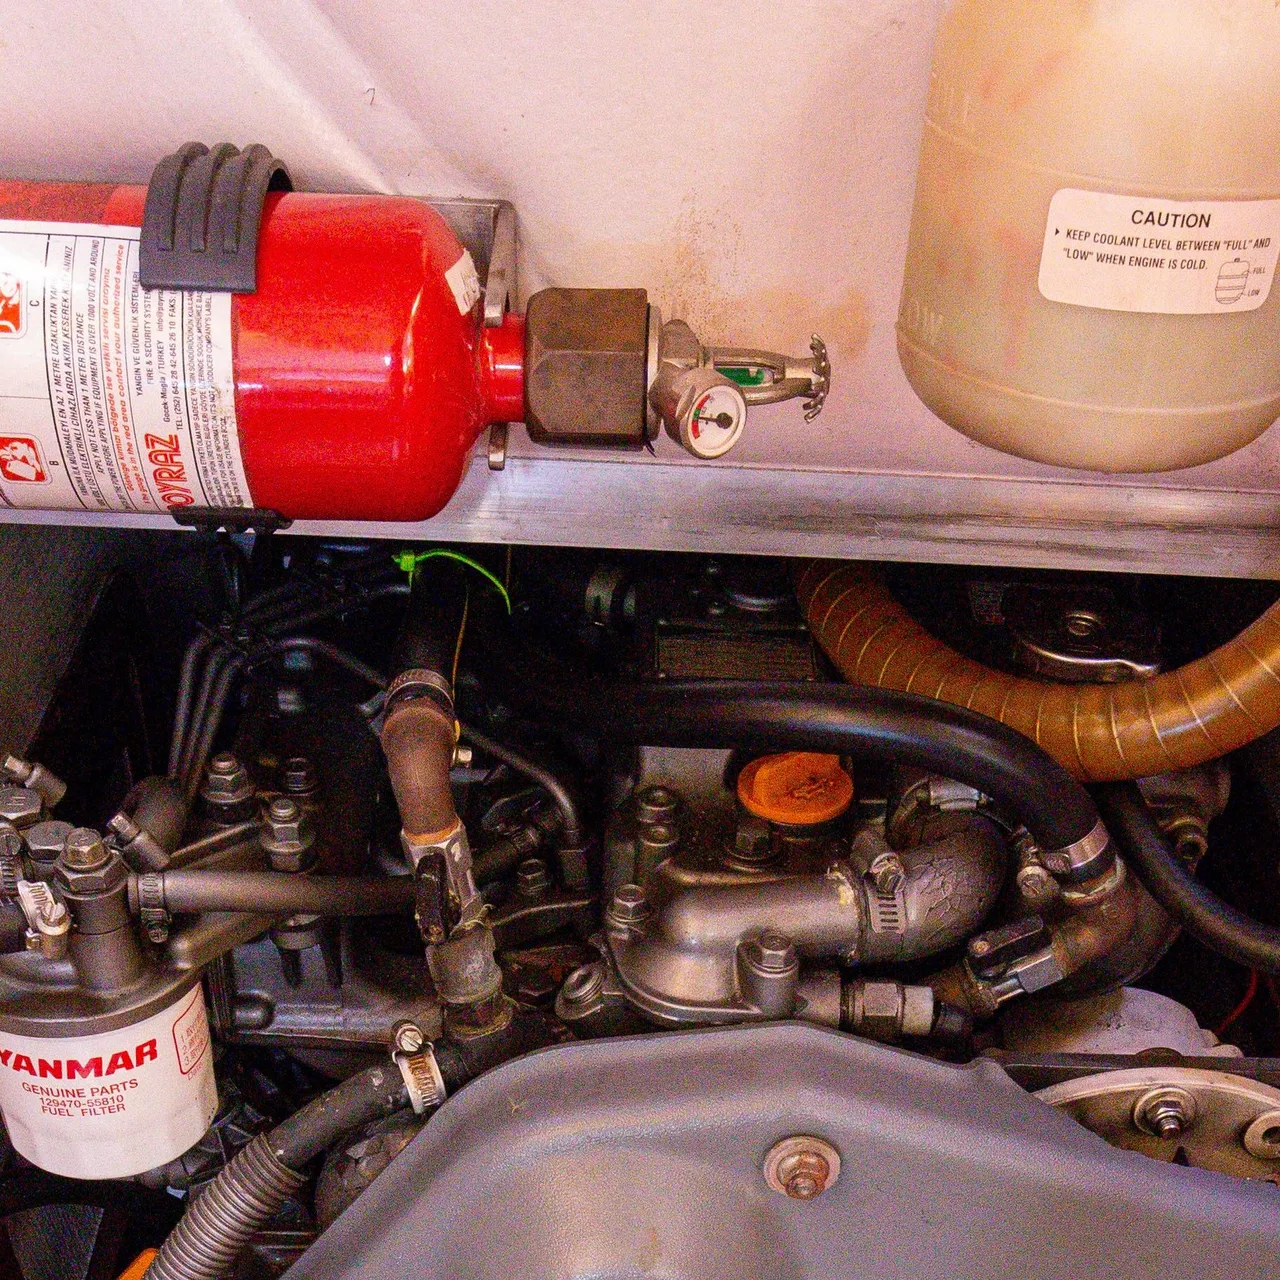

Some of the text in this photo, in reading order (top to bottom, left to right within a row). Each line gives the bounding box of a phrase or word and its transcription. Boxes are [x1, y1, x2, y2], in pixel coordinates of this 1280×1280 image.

[1131, 209, 1212, 228] CAUTION
[1065, 228, 1271, 251] KEEP COOLANT LEVEL BETWEEN "FULL" AND
[90, 240, 100, 266] AROUND
[115, 244, 124, 275] service
[1062, 247, 1208, 271] "LOW" WHEN ENGINE IS COLD.
[88, 268, 96, 282] AND
[1253, 267, 1266, 275] FULL
[87, 284, 95, 302] VOLT
[113, 277, 121, 329] authorized
[1247, 289, 1261, 297] LOW
[61, 296, 70, 339] KESEREK
[170, 321, 176, 329] 10
[50, 303, 60, 355] UZAKLIKTAN
[76, 312, 85, 354] DISTANCE
[88, 324, 96, 344] OVER
[131, 316, 140, 354] GÜVENLİK
[144, 320, 152, 357] SECURITY
[170, 333, 176, 341] 26
[114, 332, 122, 354] your
[133, 356, 140, 365] VE
[157, 340, 165, 369] TURKEY
[51, 358, 62, 387] METRE
[77, 357, 88, 386] METER
[90, 356, 101, 400] EQUIPMENT
[115, 357, 125, 398] contact
[146, 368, 154, 385] FIRE
[171, 371, 177, 379] 28
[196, 358, 205, 390] ÜERİNDE
[105, 376, 113, 390] ise
[134, 368, 143, 396] YANGIN
[55, 396, 64, 406] AZ
[82, 396, 92, 416] THAN
[120, 400, 129, 422] area
[173, 396, 182, 415] (252)
[191, 398, 199, 421] SADECE
[57, 409, 66, 418] EN
[85, 419, 96, 437] LESS
[94, 410, 108, 443] APPLYING
[122, 425, 131, 440] red
[89, 439, 100, 453] NOT
[125, 442, 135, 455] the
[93, 454, 105, 474] APPLY
[144, 433, 195, 510] OYRAZ
[22, 1078, 139, 1098] GENUINE PARTS
[40, 1094, 124, 1108] 129470-55810
[41, 1103, 126, 1117] FUEL FILTER
